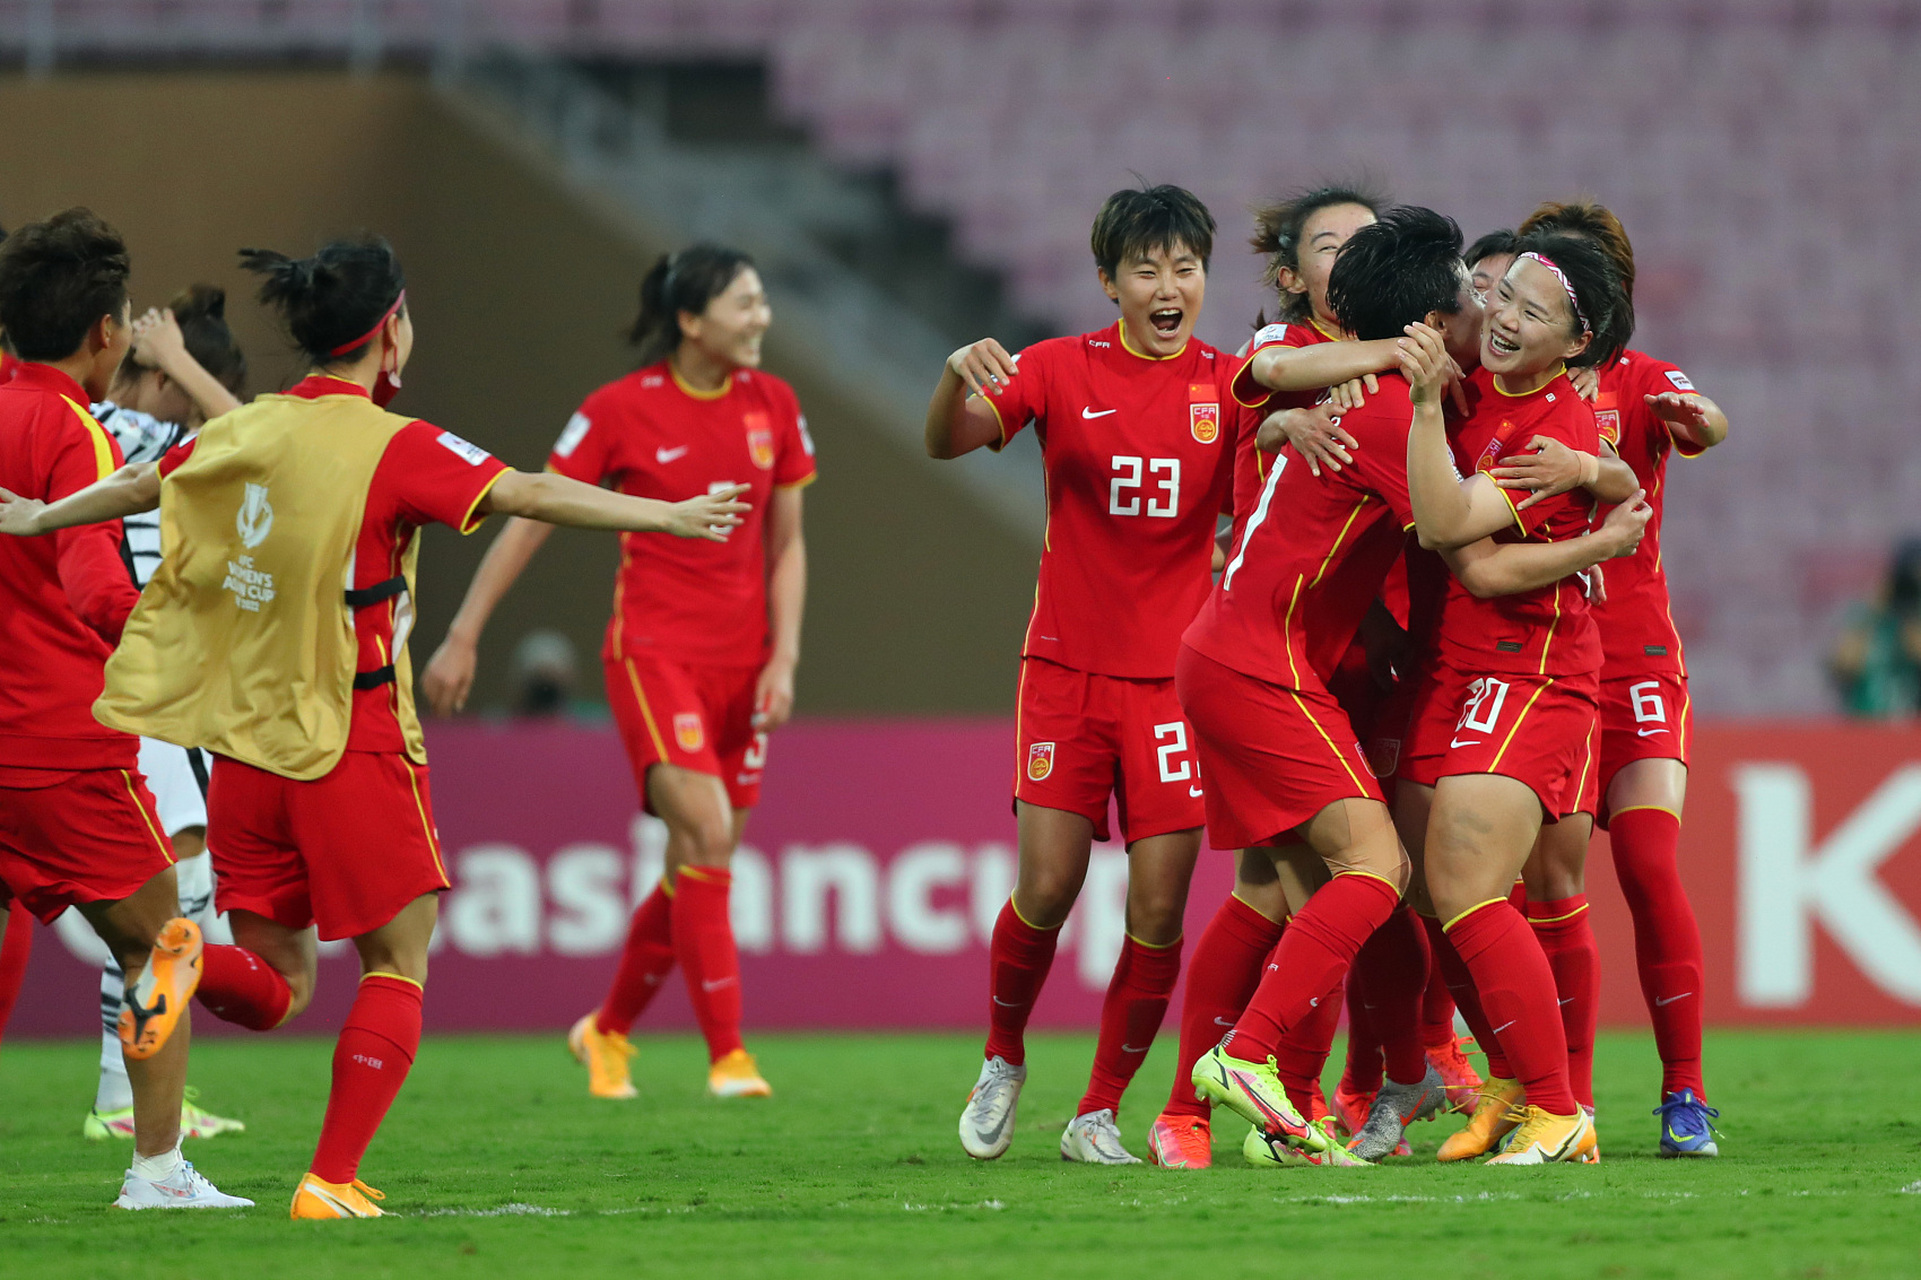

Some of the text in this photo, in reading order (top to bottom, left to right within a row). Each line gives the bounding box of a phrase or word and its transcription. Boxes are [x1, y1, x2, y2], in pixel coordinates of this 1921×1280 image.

[1088, 339, 1111, 349] CFA
[1193, 407, 1216, 415] CFA
[1108, 455, 1181, 518] 23
[247, 585, 276, 603] CUP
[1455, 677, 1510, 734] 20
[1629, 681, 1666, 723] 6
[1031, 745, 1052, 754] CFA
[1154, 721, 1201, 783] 2
